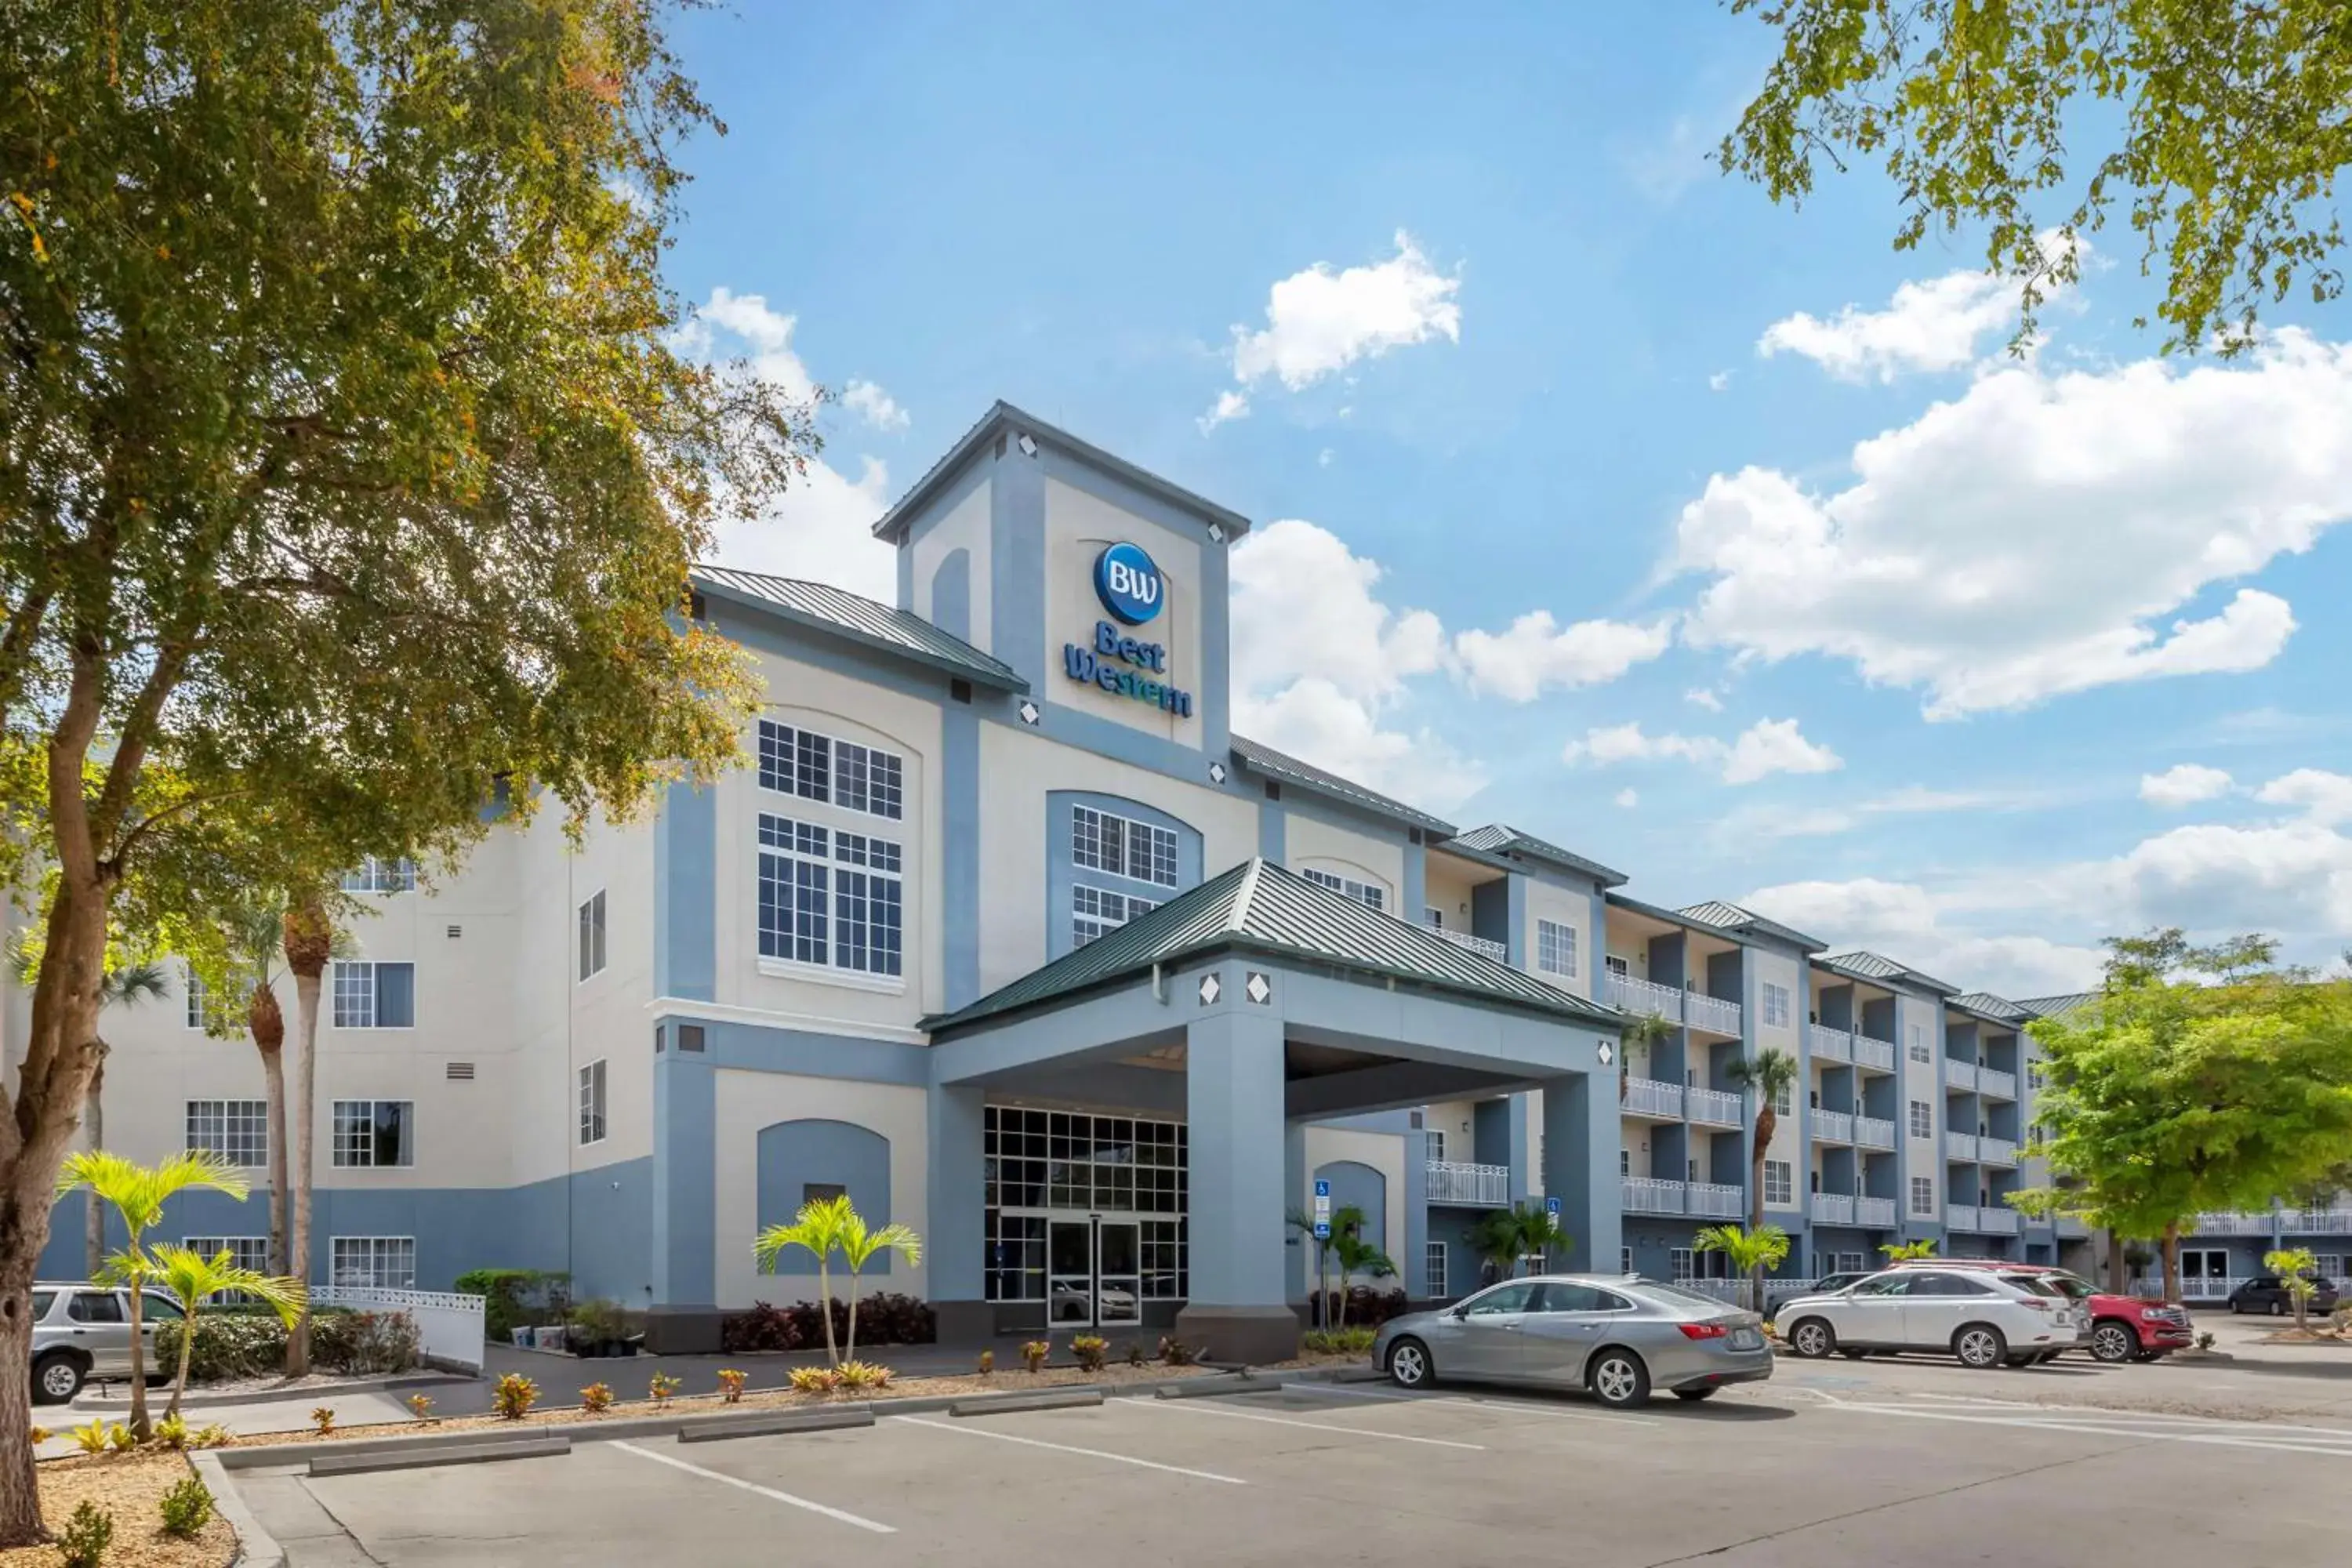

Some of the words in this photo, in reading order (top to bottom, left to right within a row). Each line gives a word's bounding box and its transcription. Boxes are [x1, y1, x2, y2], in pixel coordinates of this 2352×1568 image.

[1109, 560, 1157, 604] BW
[1095, 621, 1166, 674] Best
[1064, 643, 1192, 717] Western
